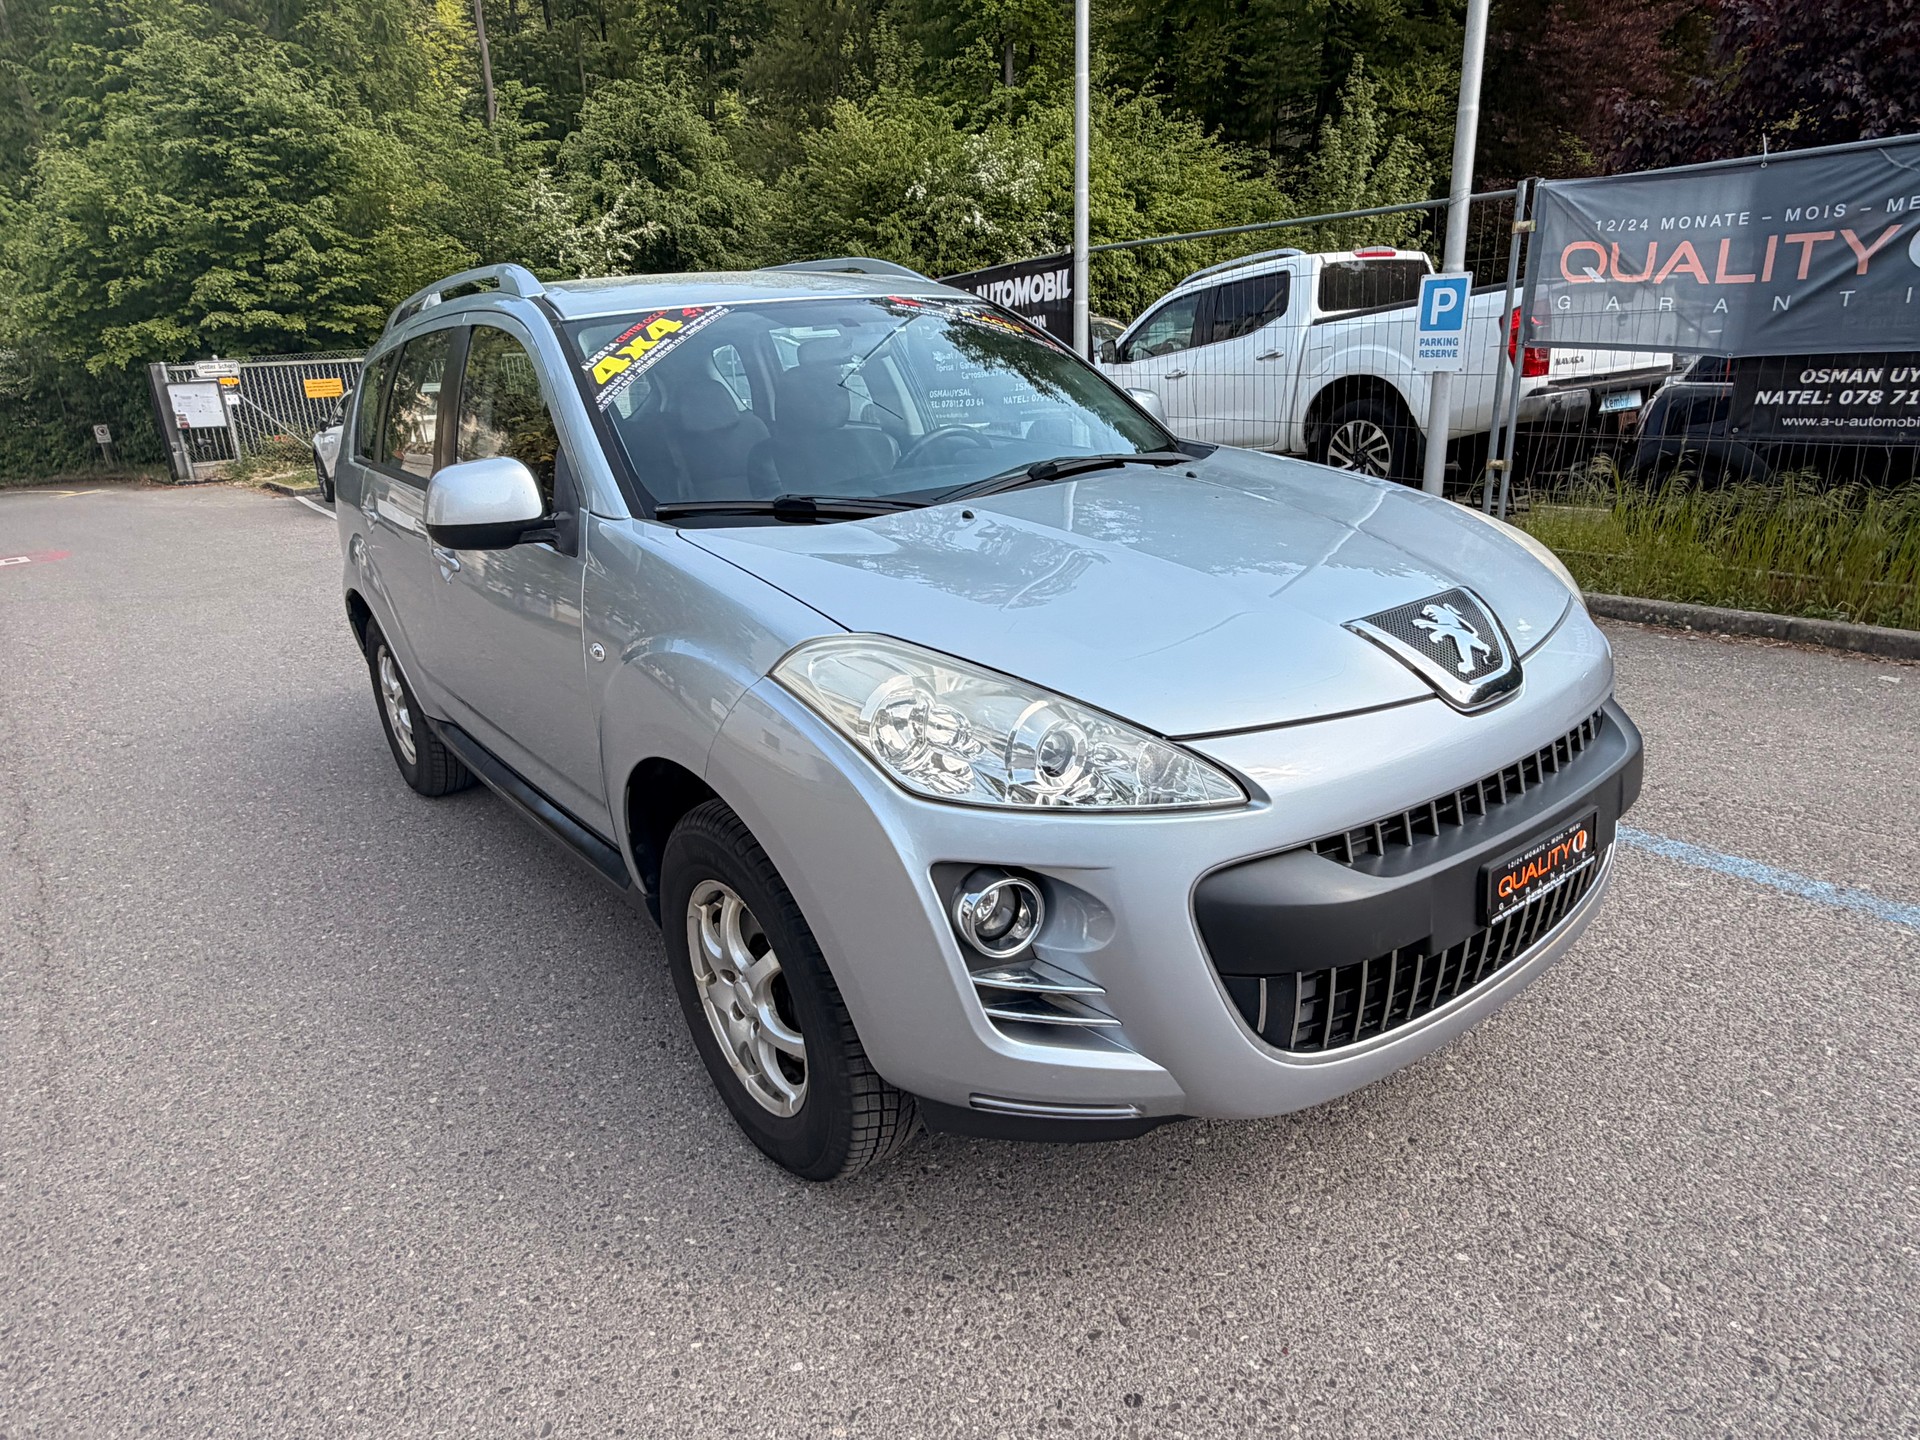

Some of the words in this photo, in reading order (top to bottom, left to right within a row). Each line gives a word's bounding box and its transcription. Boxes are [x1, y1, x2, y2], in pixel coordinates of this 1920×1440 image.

[1595, 218, 1649, 233] 12/24
[1660, 211, 1750, 231] MONATE
[1785, 203, 1847, 223] MOIS
[1559, 224, 1903, 284] QUALITY
[1430, 287, 1458, 326] P
[1557, 286, 1913, 314] GARANTI
[581, 349, 608, 371] ALPER
[615, 322, 646, 343] CENTRE
[1418, 349, 1458, 358] RESERVE
[1419, 337, 1459, 347] PARKING
[1800, 367, 1885, 384] OSMAN
[1754, 390, 1833, 405] NATEL:
[1838, 389, 1884, 405] 078
[1782, 416, 1920, 428] www.a-u-automobi
[1498, 837, 1573, 898] QUALITY
[1498, 851, 1587, 911] GARANTIE
